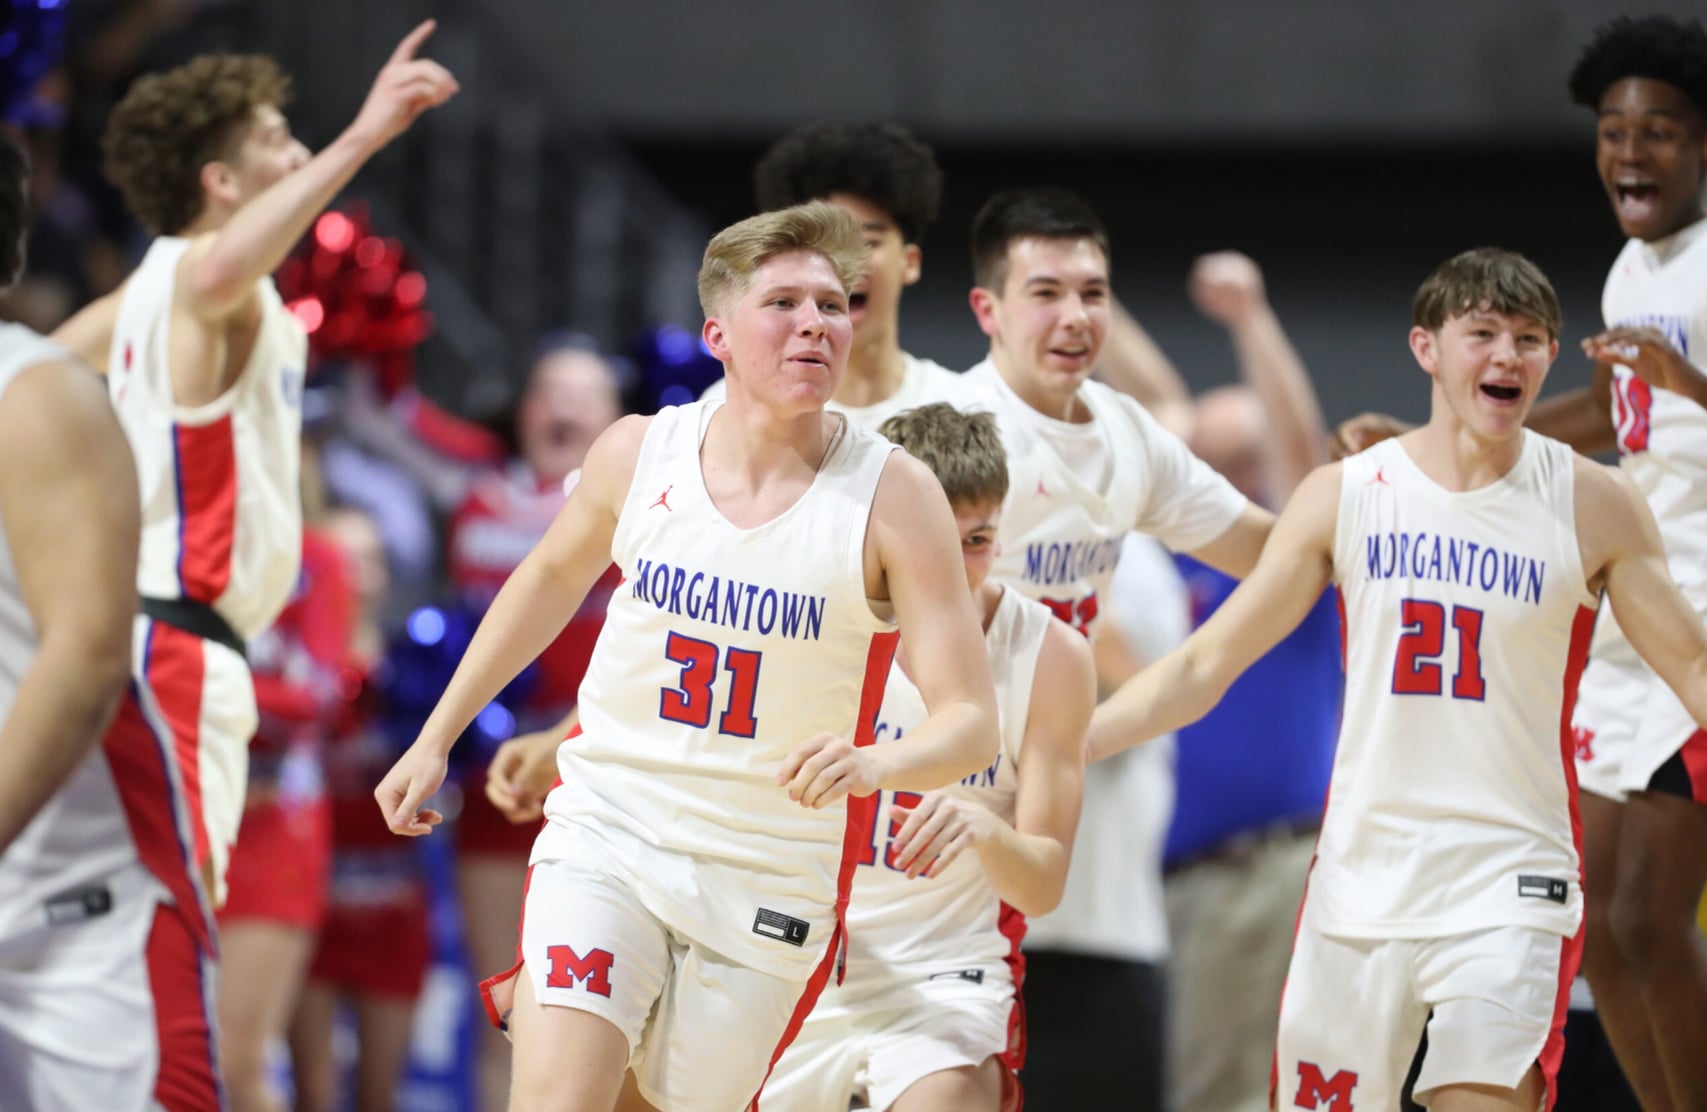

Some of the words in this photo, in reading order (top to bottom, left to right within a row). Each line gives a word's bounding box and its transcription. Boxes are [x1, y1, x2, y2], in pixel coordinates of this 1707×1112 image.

[632, 558, 826, 640] MORGANTOWN
[1366, 532, 1545, 606] MORGANTOWN
[658, 630, 762, 739] 31
[1391, 598, 1486, 702] 21
[792, 926, 800, 938] L
[546, 944, 615, 999] M
[1294, 1060, 1359, 1112] M
